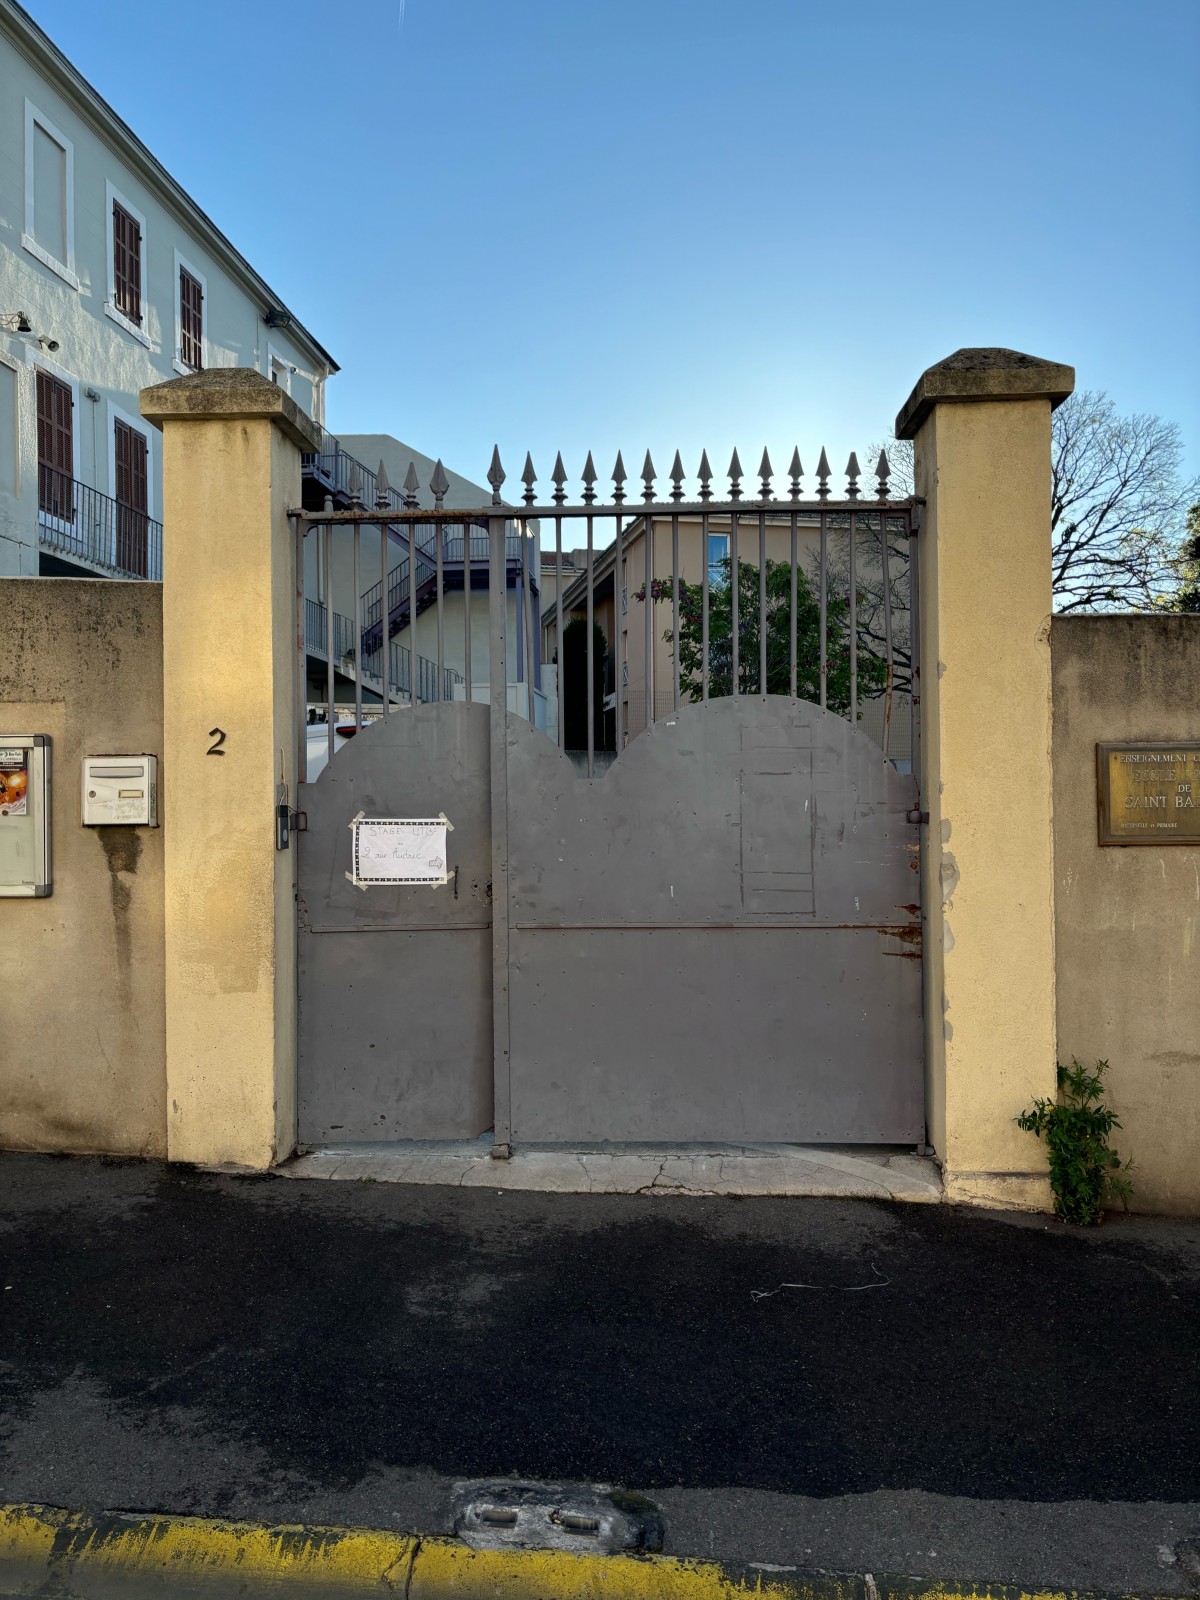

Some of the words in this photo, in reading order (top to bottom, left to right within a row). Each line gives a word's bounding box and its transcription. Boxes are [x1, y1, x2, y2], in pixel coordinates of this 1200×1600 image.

[206, 727, 226, 756] 2
[1120, 754, 1187, 763] ENSEIGNEMENT
[1193, 753, 1200, 763] C
[1132, 769, 1177, 782] ECOLE
[1177, 784, 1192, 793] DE
[1125, 795, 1168, 808] SAINT
[369, 826, 402, 837] STAGE
[360, 846, 371, 859] 2
